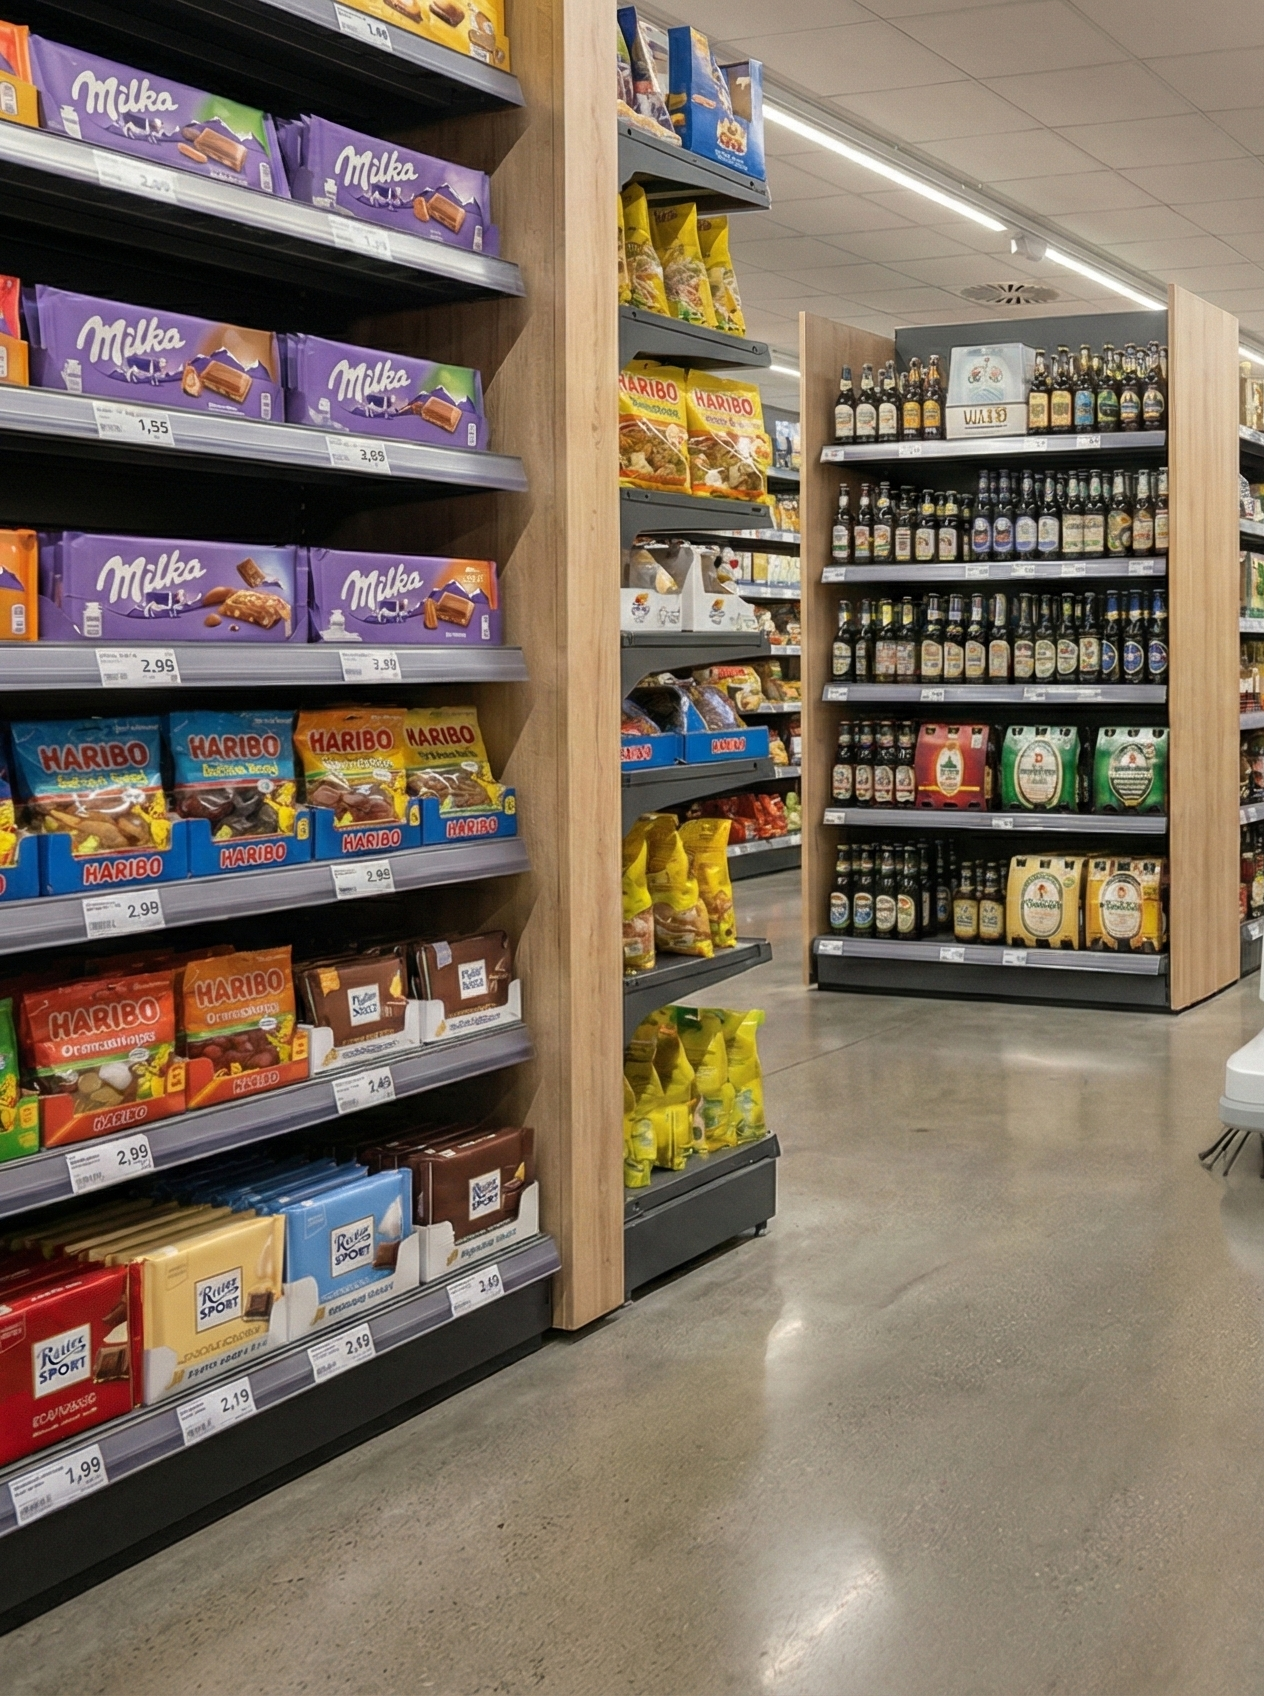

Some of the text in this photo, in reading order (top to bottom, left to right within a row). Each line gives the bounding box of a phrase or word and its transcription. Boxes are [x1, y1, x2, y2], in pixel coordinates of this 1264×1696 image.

[72, 71, 178, 119] Milka
[335, 145, 418, 189] Milka
[77, 316, 185, 364] Milka
[328, 359, 410, 401] Milka
[693, 388, 754, 417] HARIBO
[138, 418, 169, 437] 1,55
[97, 549, 207, 603] Milka
[341, 562, 423, 610] Milka
[188, 734, 280, 760] HARIBO
[308, 728, 394, 755] HARIBO
[406, 725, 475, 747] HARIBO
[38, 741, 150, 773] HARIBO
[220, 842, 287, 869] HARIBO
[342, 829, 401, 853] HARIBO
[84, 856, 162, 885] HARIBO
[194, 968, 284, 1009] HARIBO
[49, 997, 160, 1042] HARIBO
[116, 1143, 149, 1167] 2,99
[220, 1388, 250, 1413] 2,19
[65, 1456, 101, 1485] 1,99
